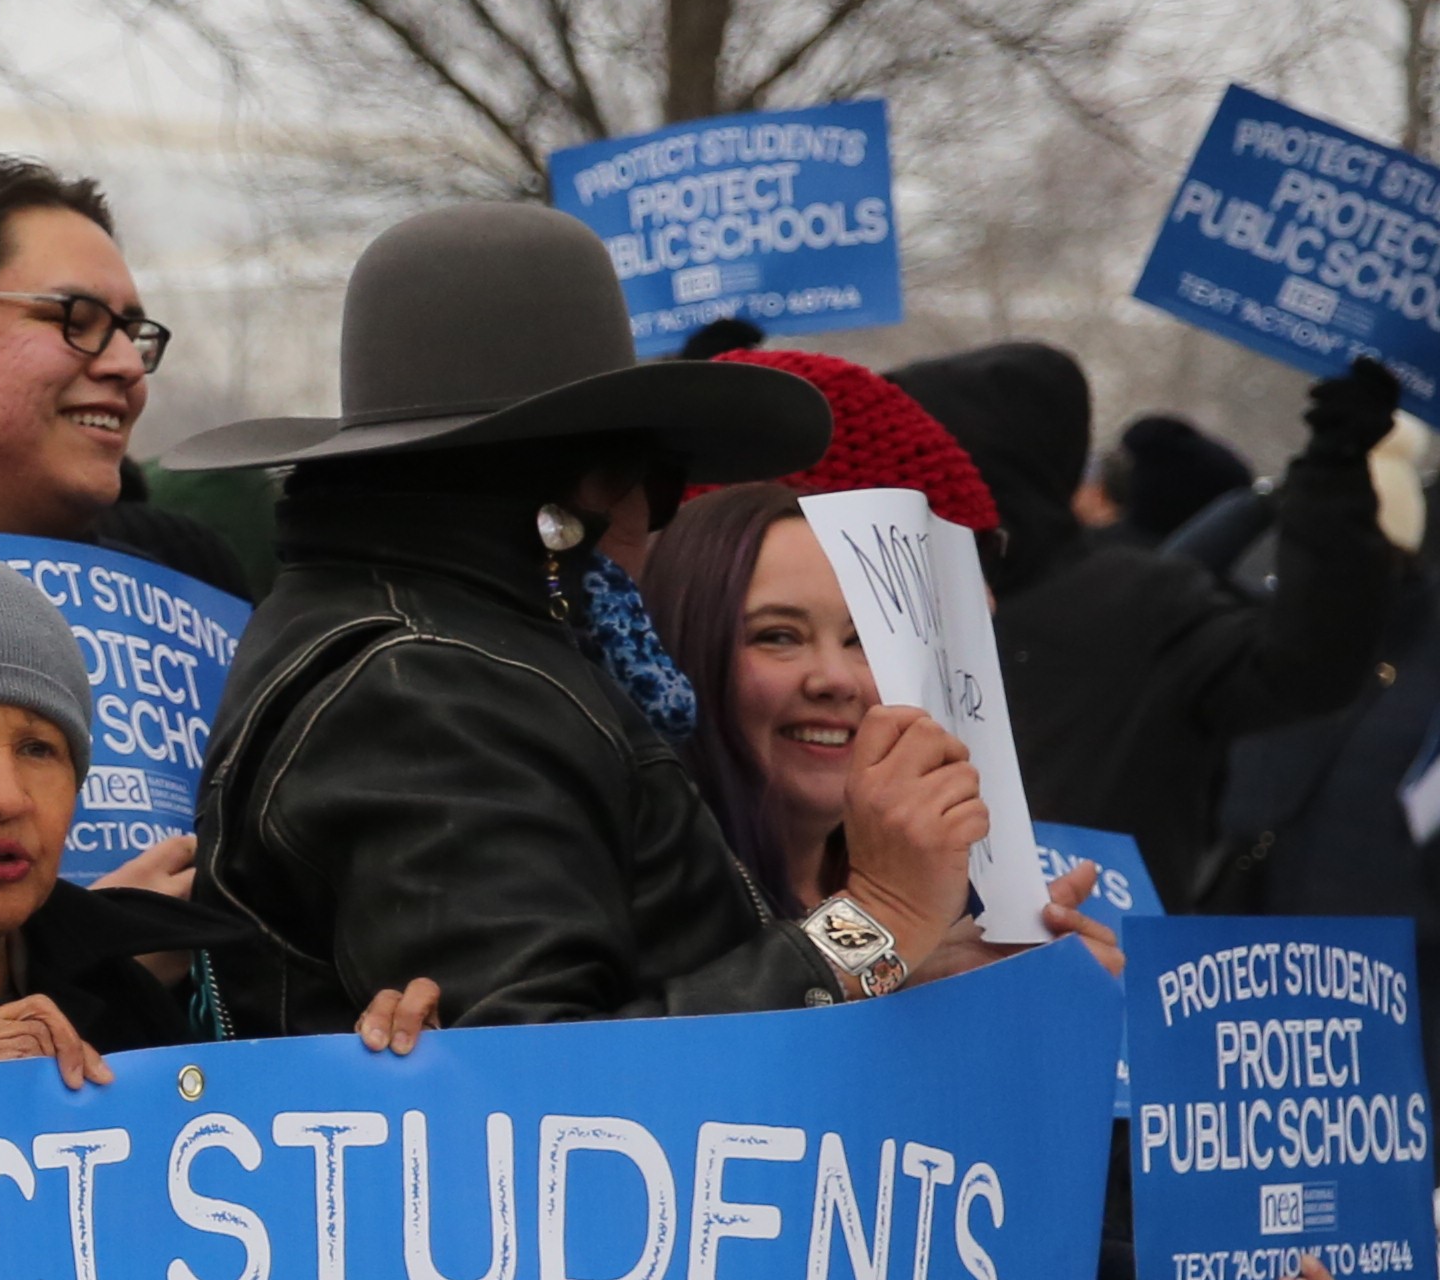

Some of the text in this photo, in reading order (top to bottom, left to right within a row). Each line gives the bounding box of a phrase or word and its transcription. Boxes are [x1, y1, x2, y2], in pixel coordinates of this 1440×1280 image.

[573, 123, 868, 207] PROTECT STUDENTS
[1232, 118, 1386, 189] PROTECT
[627, 161, 801, 229] PROTECT
[603, 196, 889, 281] BLIC SCHOOLS
[1173, 179, 1326, 274] PUBLIC
[1318, 239, 1440, 332] SCHO
[71, 625, 199, 710] OTECT
[88, 771, 147, 807] nea
[1157, 942, 1408, 1027] PROTECT STUDENTS
[1216, 1018, 1362, 1091] PROTECT
[1140, 1092, 1427, 1174] PUBLIC SCHOOLS
[1265, 1190, 1302, 1228] nea
[1326, 1243, 1355, 1276] TO
[1358, 1241, 1413, 1274] 48744
